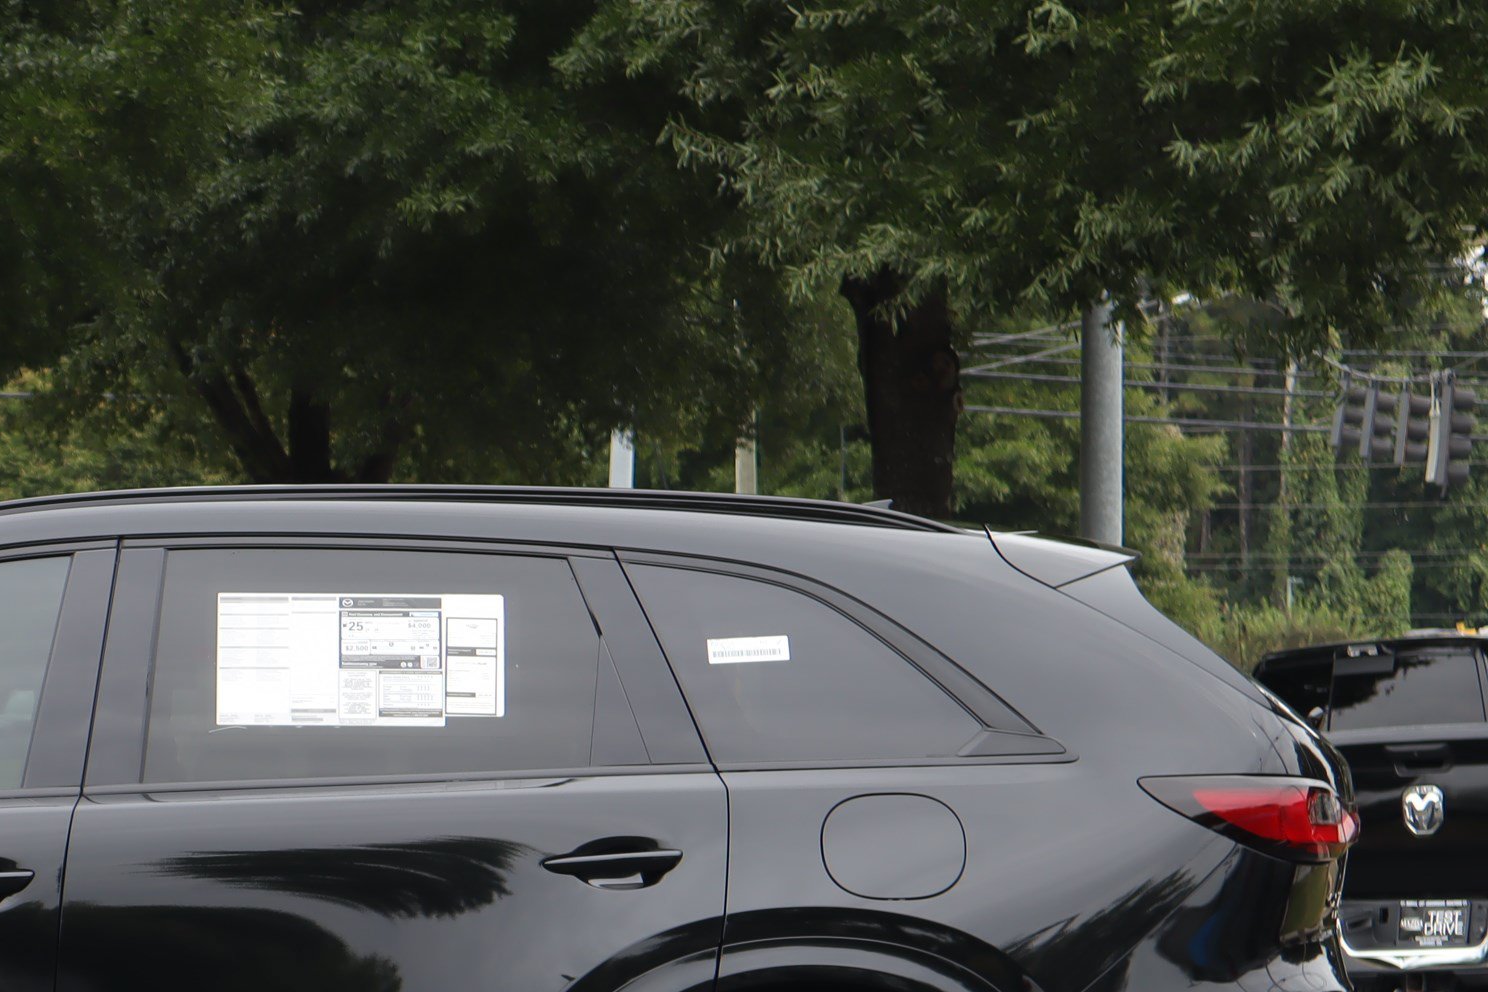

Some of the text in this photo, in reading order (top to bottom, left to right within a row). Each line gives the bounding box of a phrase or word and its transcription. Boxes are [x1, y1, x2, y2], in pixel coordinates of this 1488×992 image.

[348, 621, 364, 632] 25
[1427, 910, 1462, 924] TEST
[1424, 922, 1464, 936] DRIVE
